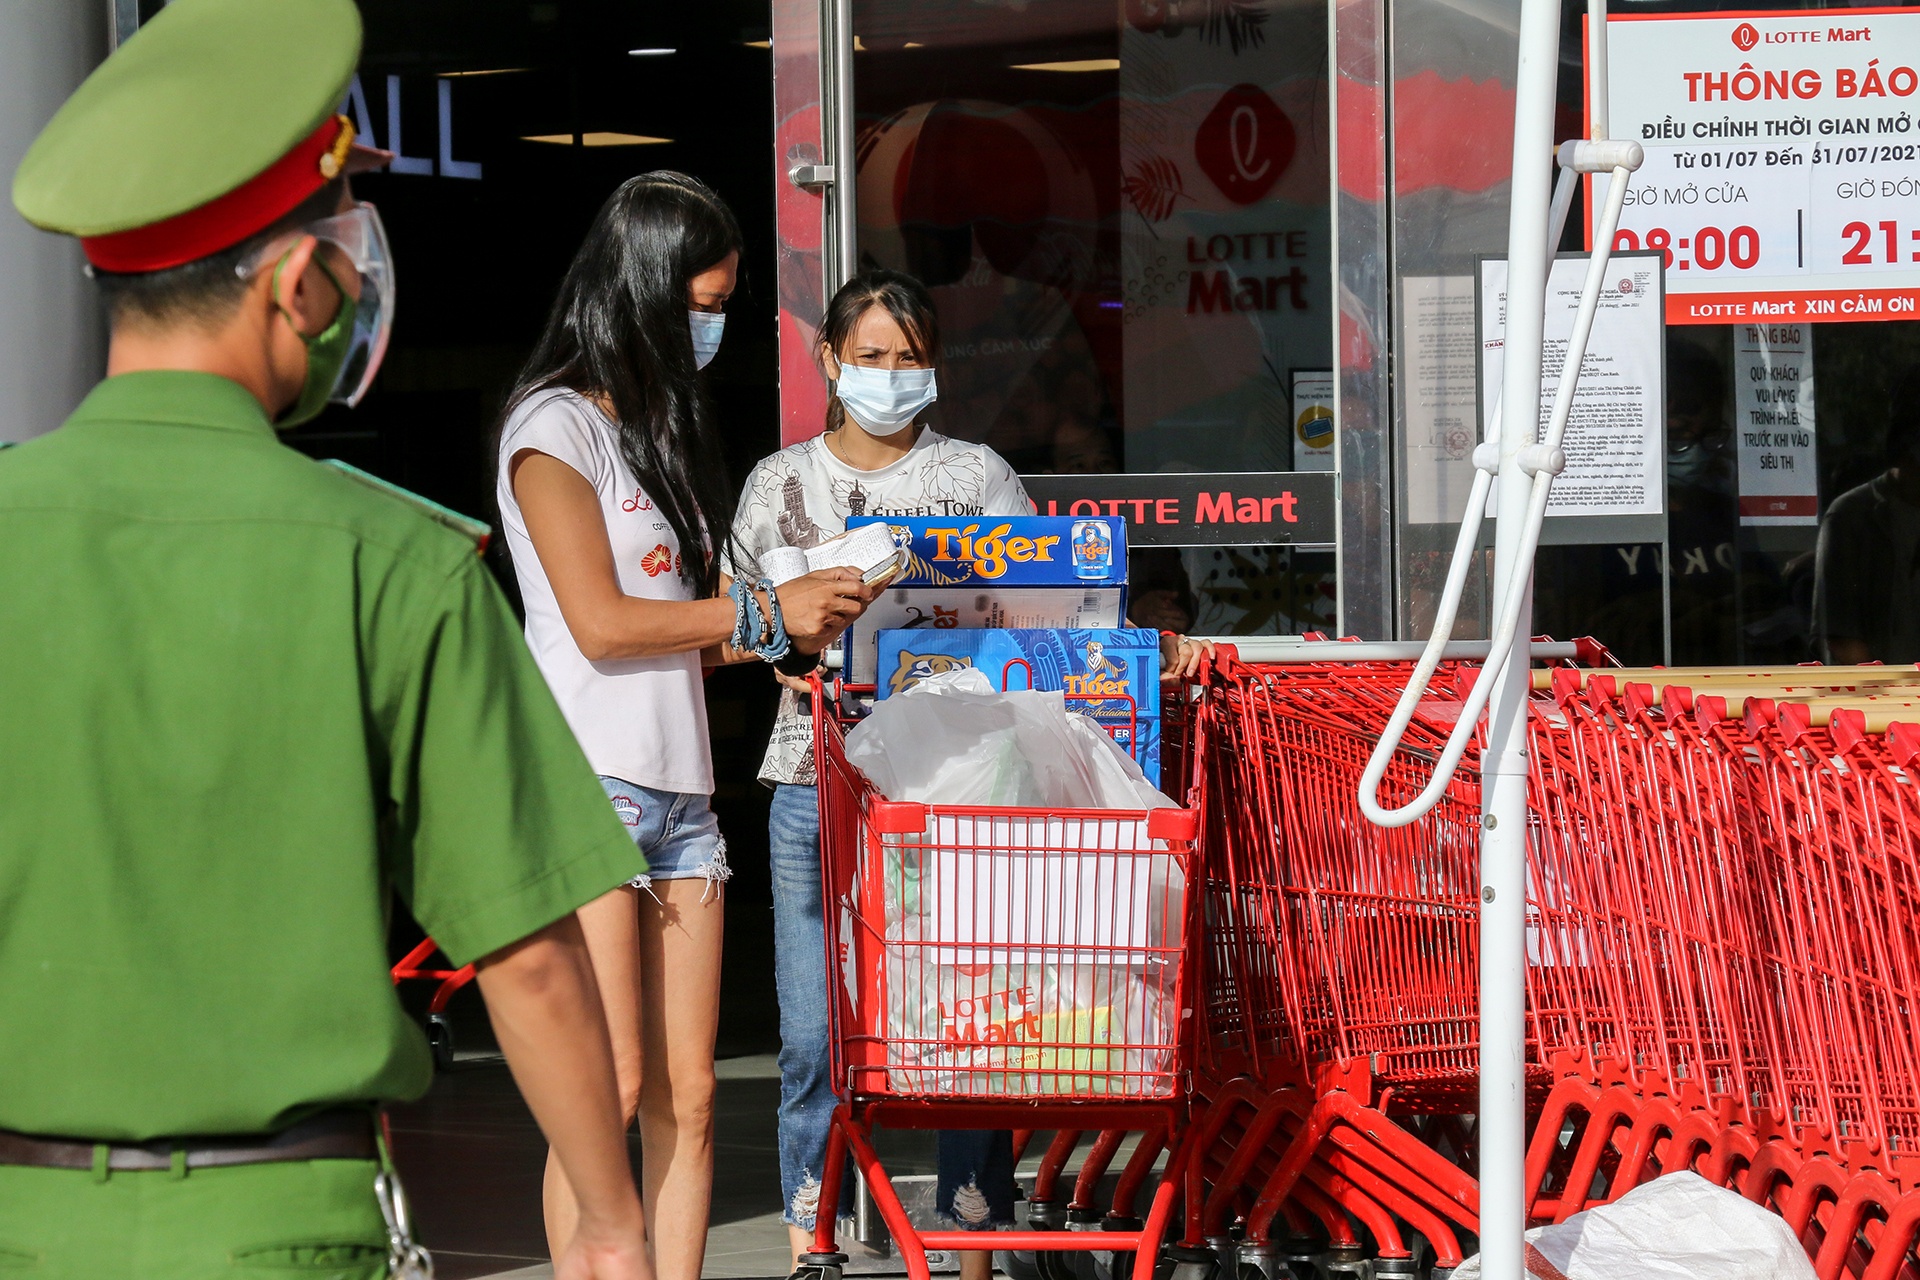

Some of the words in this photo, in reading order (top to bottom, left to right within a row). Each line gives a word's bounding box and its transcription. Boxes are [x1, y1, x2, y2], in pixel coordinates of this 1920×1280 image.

[1765, 31, 1821, 43] LOTTE
[1827, 27, 1871, 42] Mart
[1683, 62, 1822, 102] THÔNG
[1836, 58, 1919, 98] BÁO
[1642, 114, 1686, 139] ĐIỀU
[1692, 115, 1758, 138] CHỈNH
[1765, 115, 1811, 136] THỜI
[1818, 118, 1870, 135] GIAN
[1877, 111, 1911, 134] MỞ
[1673, 151, 1696, 169] Từ
[1701, 151, 1758, 169] 01/07
[1765, 147, 1803, 166] Đến
[1622, 185, 1658, 206] GIỜ
[1664, 182, 1699, 205] MỞ
[1705, 181, 1749, 204] CỬA
[1837, 177, 1875, 199] GIỜ
[1186, 230, 1307, 262] LOTTE
[1186, 266, 1309, 315] Mart
[1690, 303, 1746, 317] LOTTE
[1752, 300, 1796, 316] Mart
[1805, 299, 1836, 315] XIN
[1841, 294, 1883, 314] CẢM
[1888, 296, 1915, 313] ƠN
[1781, 325, 1801, 344] BÁO
[1770, 364, 1799, 381] KHÁCH
[1774, 433, 1788, 448] KHI
[1791, 430, 1810, 448] VÀO
[1760, 452, 1778, 470] SIÊU
[1194, 491, 1298, 524] Mart
[924, 523, 1061, 579] Tiger
[1075, 543, 1109, 561] Tiger
[1063, 673, 1131, 705] Tiger
[945, 1010, 1041, 1053] Mart
